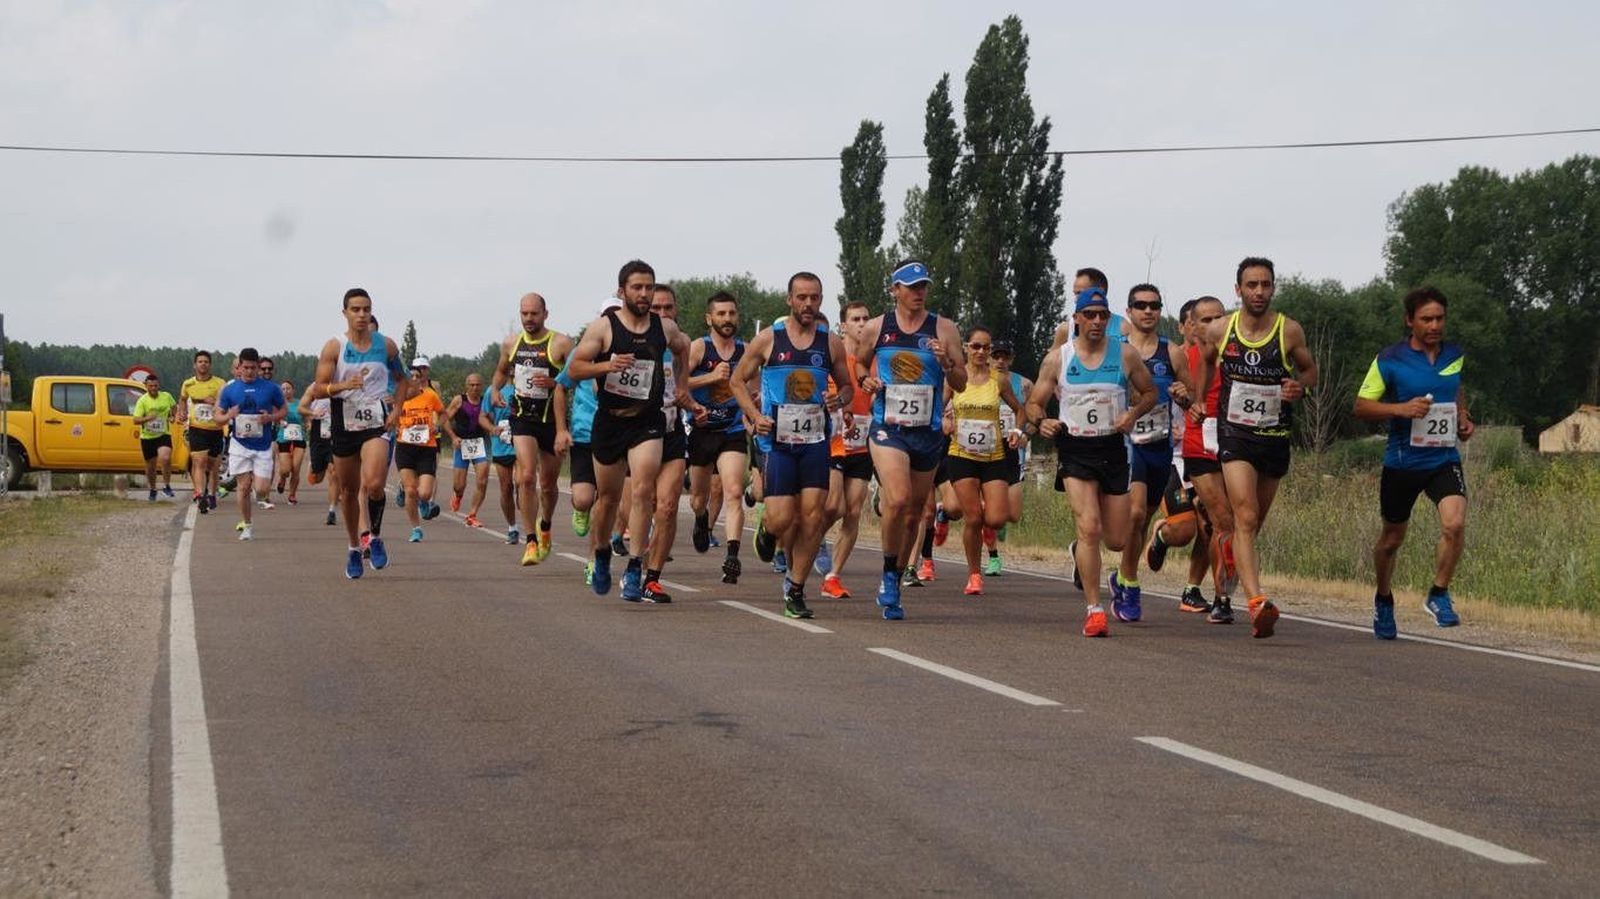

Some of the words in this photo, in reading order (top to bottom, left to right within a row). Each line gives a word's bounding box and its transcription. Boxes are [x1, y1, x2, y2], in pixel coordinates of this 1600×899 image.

[619, 372, 639, 387] 86
[898, 400, 919, 415] 25
[1242, 400, 1266, 415] 84
[354, 409, 372, 421] 48
[1087, 409, 1098, 424] 6
[245, 424, 251, 432] 9
[792, 420, 812, 433] 14
[1136, 420, 1156, 434] 51
[1427, 420, 1449, 435] 28
[410, 433, 421, 442] 26
[968, 432, 986, 445] 62
[467, 446, 478, 454] 92
